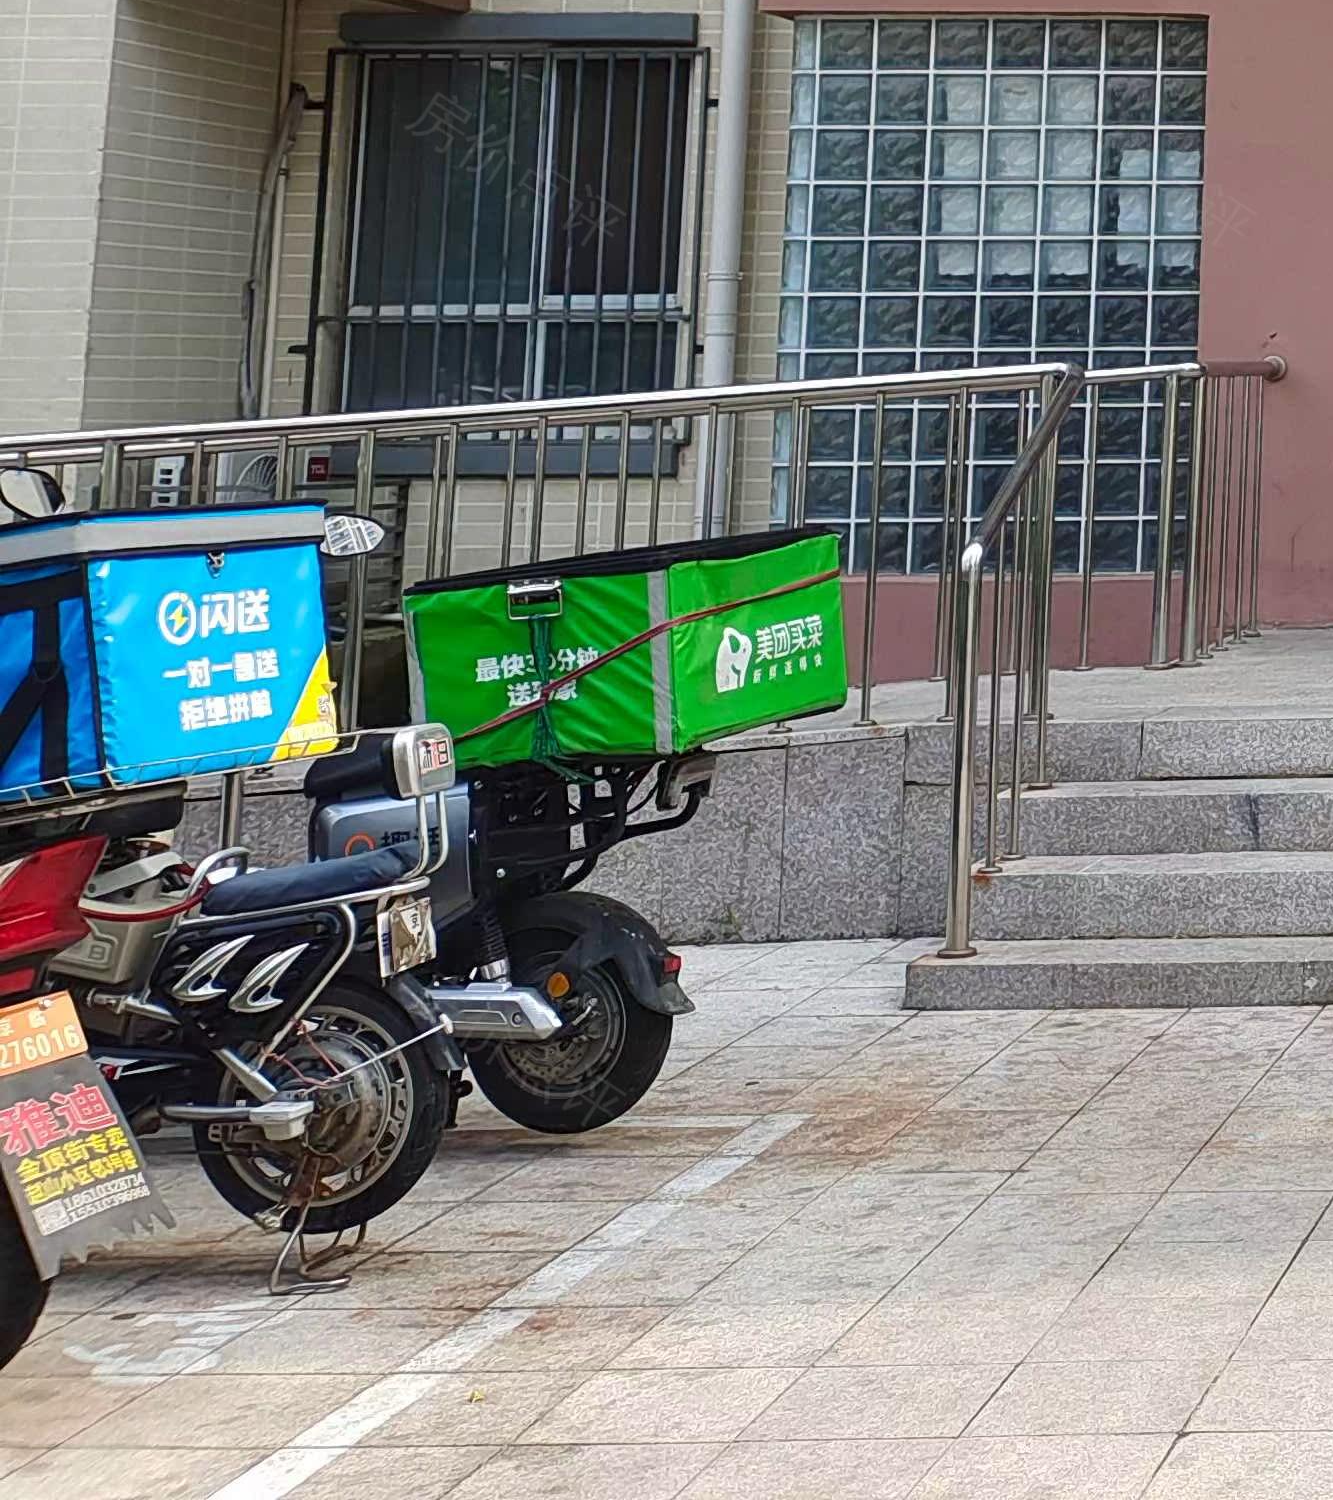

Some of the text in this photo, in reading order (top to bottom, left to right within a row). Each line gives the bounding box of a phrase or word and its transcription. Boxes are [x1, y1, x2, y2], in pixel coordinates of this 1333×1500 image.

[201, 588, 270, 637] 闪送
[755, 615, 823, 664] 美团买菜
[0, 1083, 118, 1158] 雅迪
